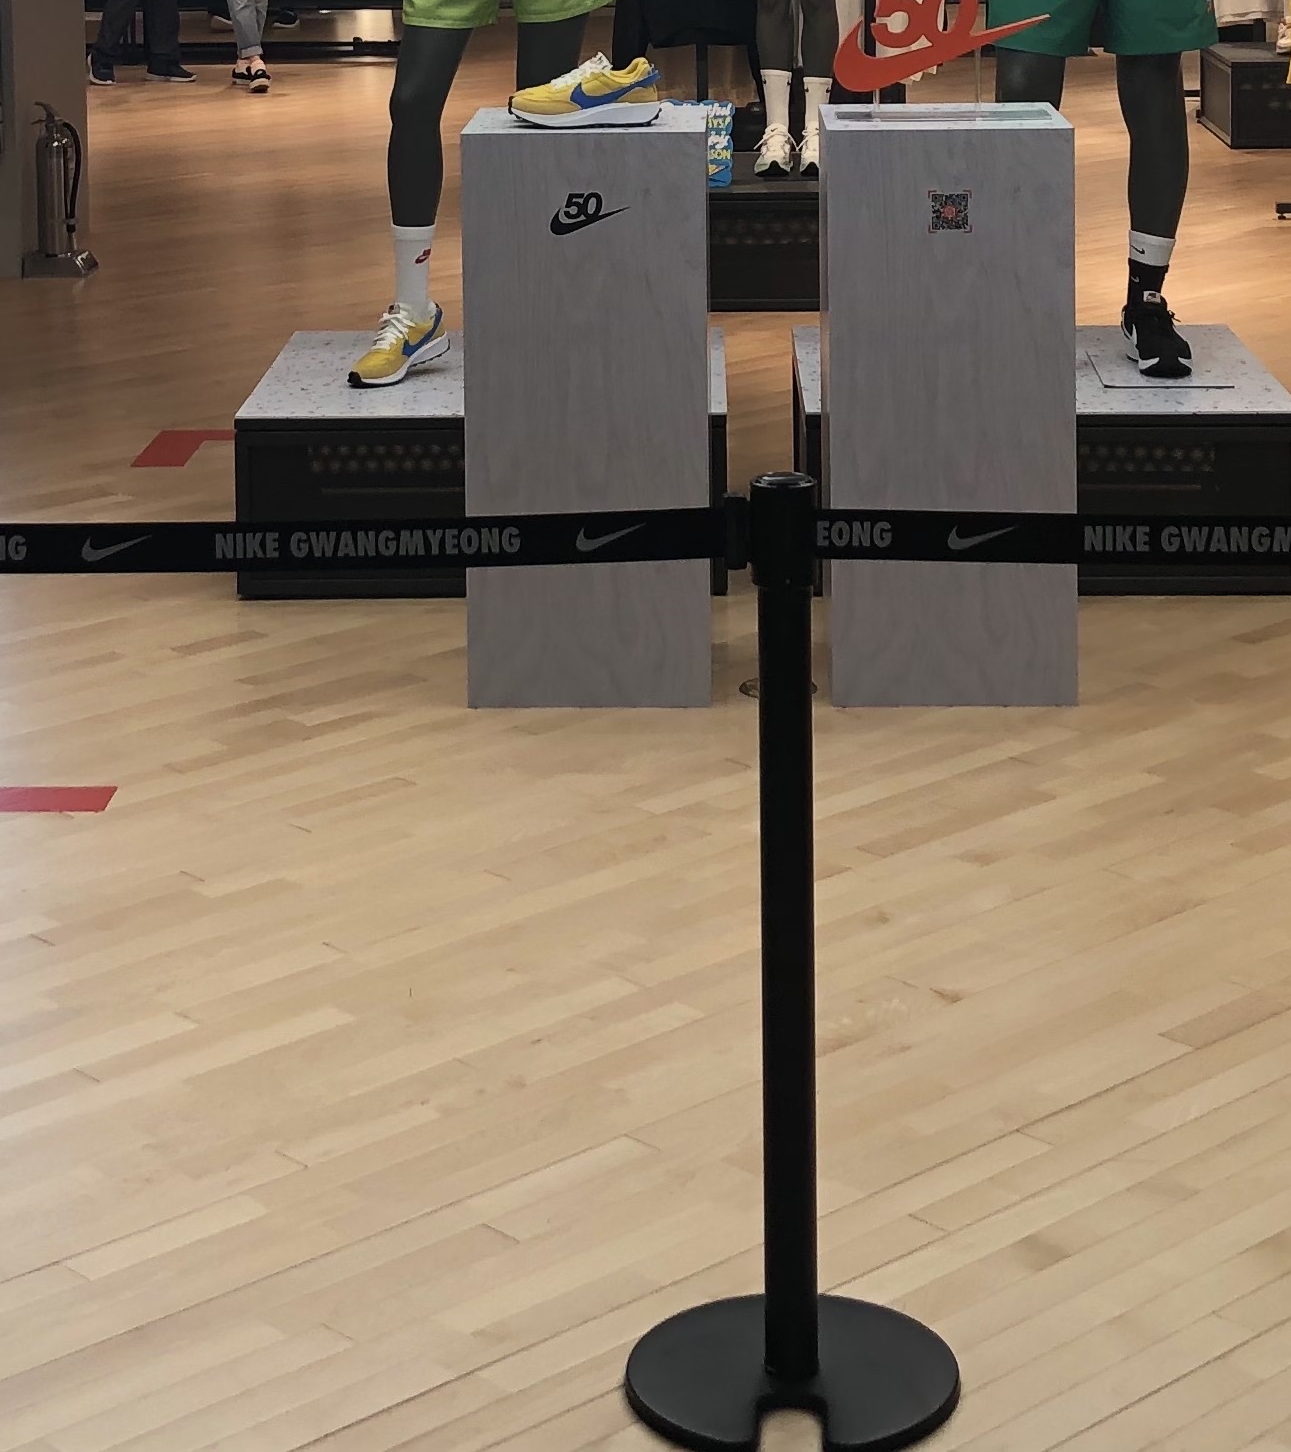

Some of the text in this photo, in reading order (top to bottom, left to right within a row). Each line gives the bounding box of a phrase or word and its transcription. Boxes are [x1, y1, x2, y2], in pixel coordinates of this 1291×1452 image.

[563, 191, 603, 220] 50
[215, 526, 521, 559] NIKE GWANGMYEONG
[1084, 525, 1150, 552] NIKE
